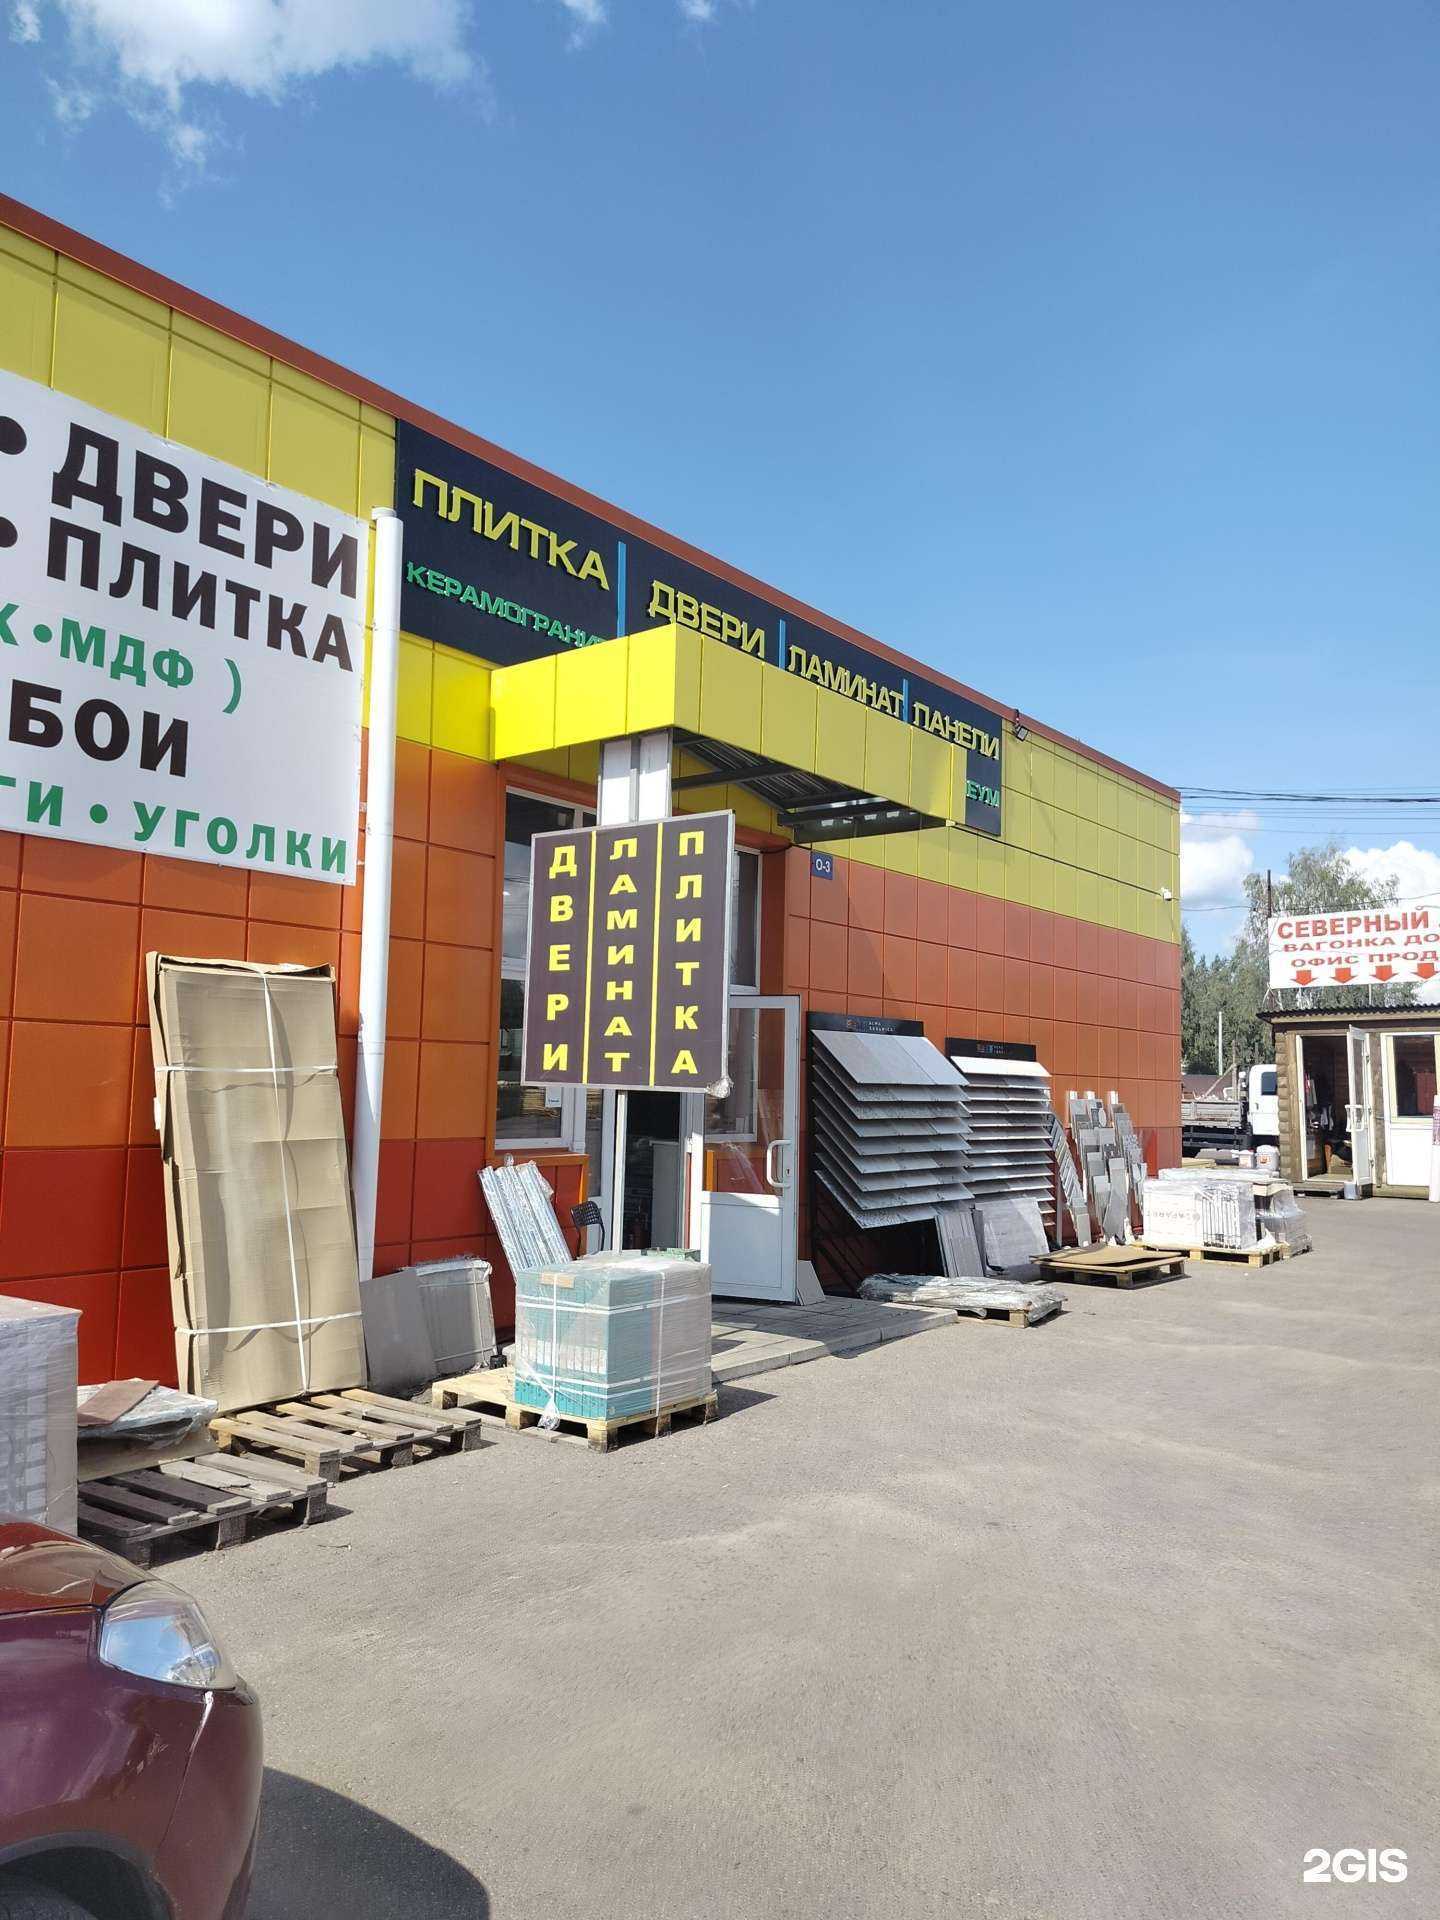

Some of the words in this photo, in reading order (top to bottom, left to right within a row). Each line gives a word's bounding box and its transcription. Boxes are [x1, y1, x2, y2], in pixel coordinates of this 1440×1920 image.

[51, 422, 358, 599] ДВЕРИ
[413, 468, 610, 591] ПЛИТКА
[46, 517, 354, 672] ПЛИТКА
[406, 561, 608, 648] КЕРАМОГРАНИ
[648, 580, 765, 659] ДВЕРИ
[787, 645, 904, 717] ЛАМИНАТ
[8, 678, 189, 778] БОИ
[912, 701, 1000, 761] ПАНЕЛИ
[132, 800, 347, 875] УГОЛКИ
[542, 844, 578, 1071] ДВЕРИ
[604, 837, 638, 1072] ЛАМИНАТ
[671, 830, 705, 1074] ПЛИТКА
[1277, 904, 1429, 940] СЕВЕРНЫЙ
[1283, 936, 1396, 953] ВАГОНКА
[1404, 933, 1440, 947] ДО
[1291, 955, 1360, 968] ОФИС
[1368, 950, 1439, 963] ПРОД
